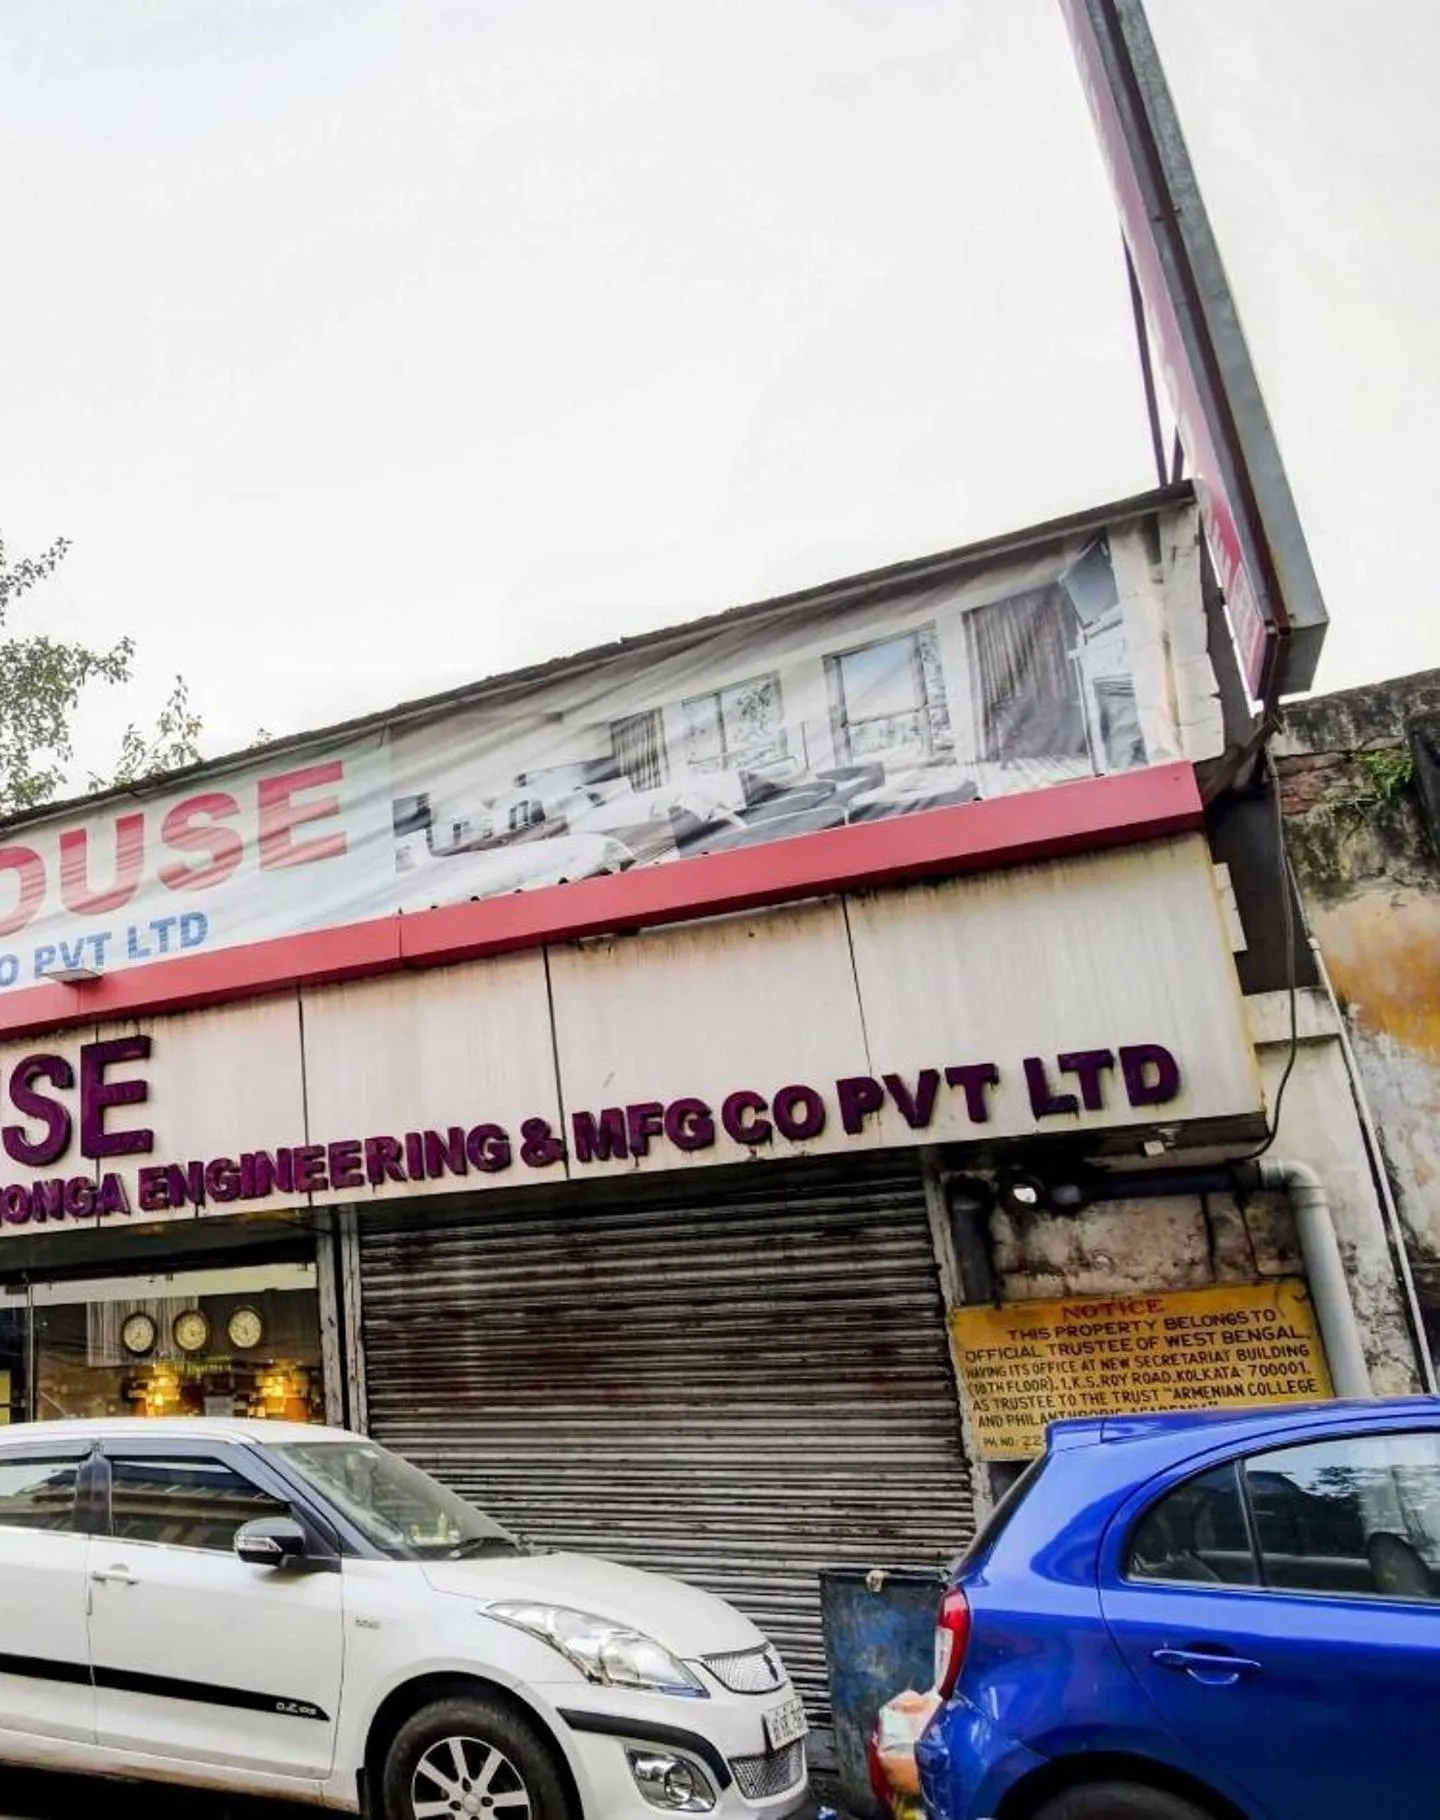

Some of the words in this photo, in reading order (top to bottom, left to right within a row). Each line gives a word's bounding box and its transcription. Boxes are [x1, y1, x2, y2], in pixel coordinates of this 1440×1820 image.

[34, 931, 113, 979] PVT
[127, 911, 209, 960] LTD
[137, 1123, 512, 1211] ENGINEERING
[519, 1116, 566, 1168] &
[571, 1097, 716, 1164] MFG
[721, 1084, 827, 1145] CO
[836, 1062, 999, 1135] PVT
[1023, 1043, 1181, 1120] LTD
[1007, 1327, 1051, 1342] THIS
[1055, 1319, 1157, 1339] PROPERTY
[1164, 1311, 1249, 1331] BELONGS
[1250, 1308, 1276, 1324] TO
[1062, 1298, 1165, 1319] NOTICE
[965, 1345, 1042, 1363] OFFICIAL
[1046, 1337, 1132, 1357] TRUSTEE
[1136, 1335, 1160, 1351] OF
[1164, 1331, 1217, 1348] WEST
[1008, 1363, 1031, 1377] ITS
[1032, 1360, 1075, 1375] OFFICE
[1080, 1358, 1096, 1372] AT
[1100, 1356, 1129, 1371] NEW
[1134, 1350, 1230, 1369] SECRETARIAT
[1236, 1343, 1310, 1362] BUILDING
[973, 1400, 989, 1412] AS
[994, 1395, 1056, 1410] TRUSTEE
[1059, 1393, 1076, 1407] TO
[1079, 1391, 1107, 1406] THE
[1111, 1388, 1158, 1404] TRUST
[1247, 1378, 1318, 1396] COLLEGE
[978, 1414, 1003, 1428] AND
